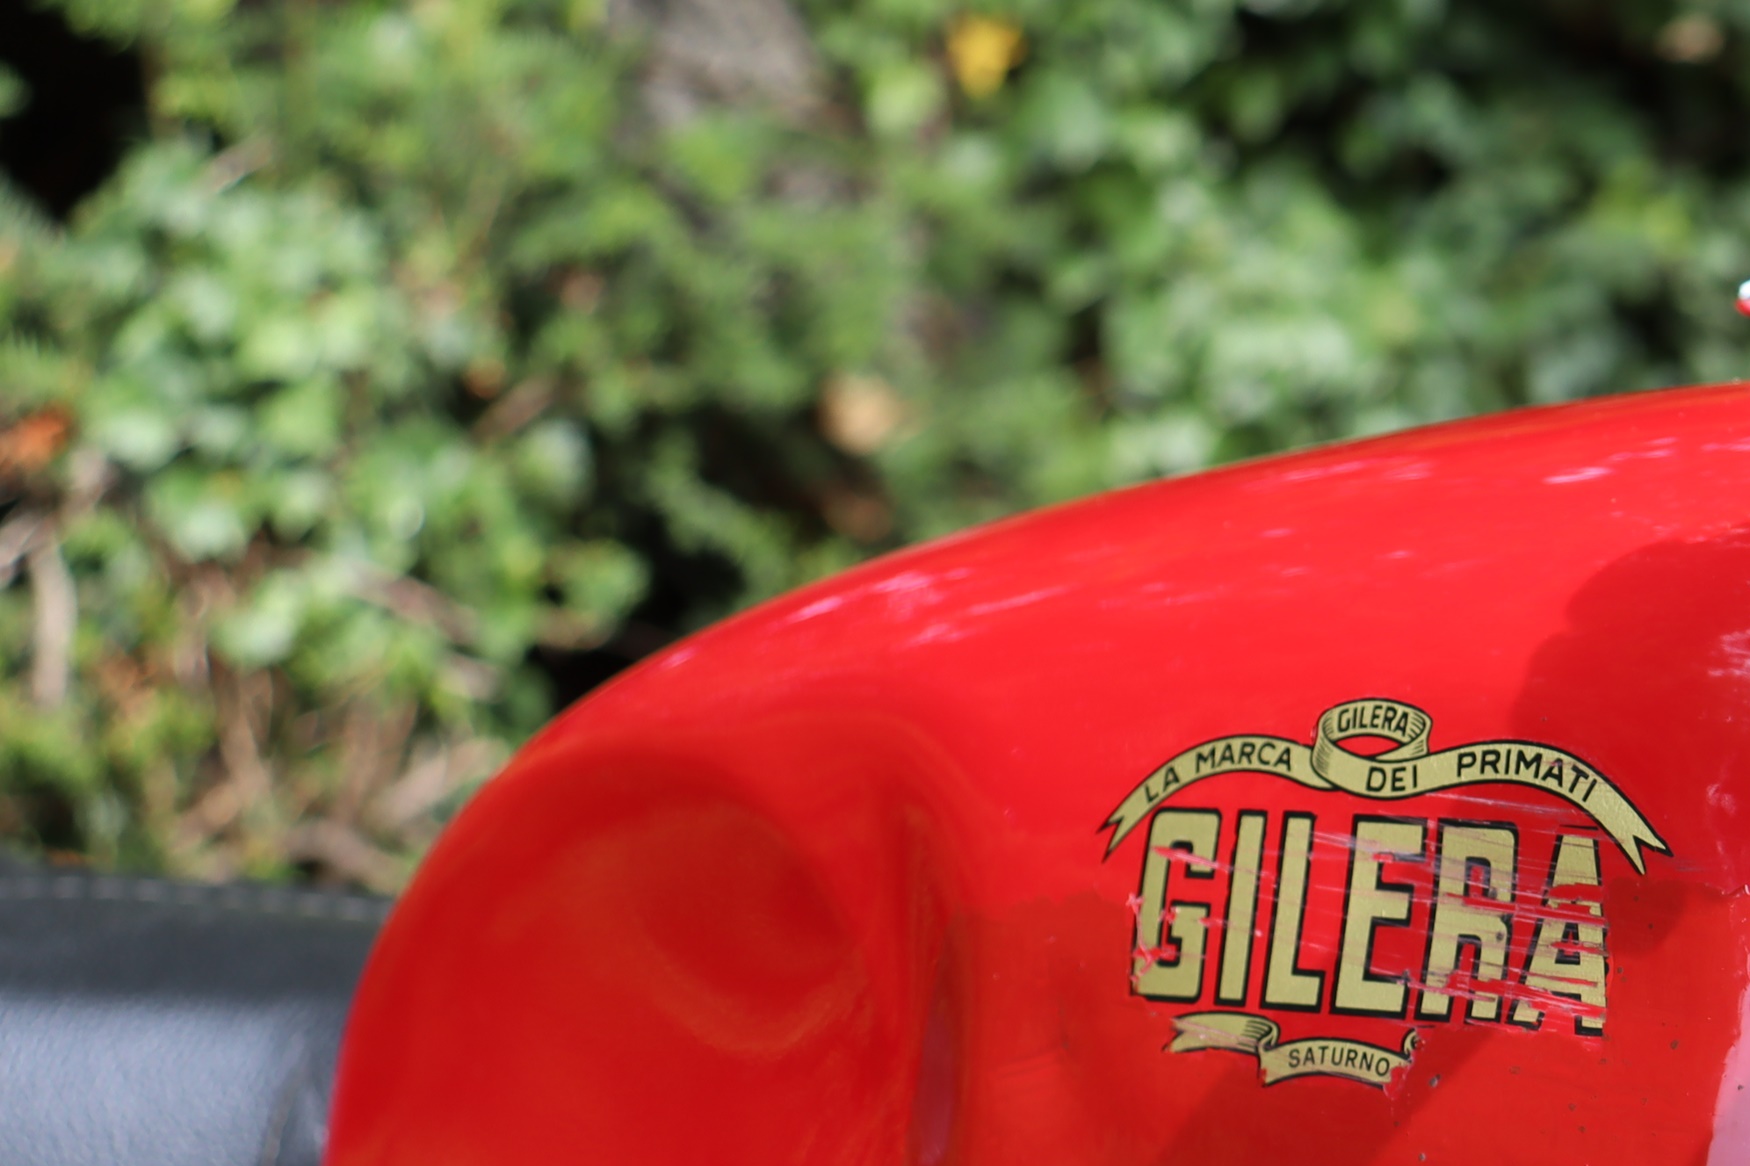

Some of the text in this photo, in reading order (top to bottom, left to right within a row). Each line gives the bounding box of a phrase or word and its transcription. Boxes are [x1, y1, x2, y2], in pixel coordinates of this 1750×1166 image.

[1337, 704, 1409, 737] GILERA
[1143, 744, 1597, 803] LA MARCA DEI PRIMATI
[1130, 806, 1609, 1037] GILERA
[1287, 1048, 1391, 1077] SATURNO
